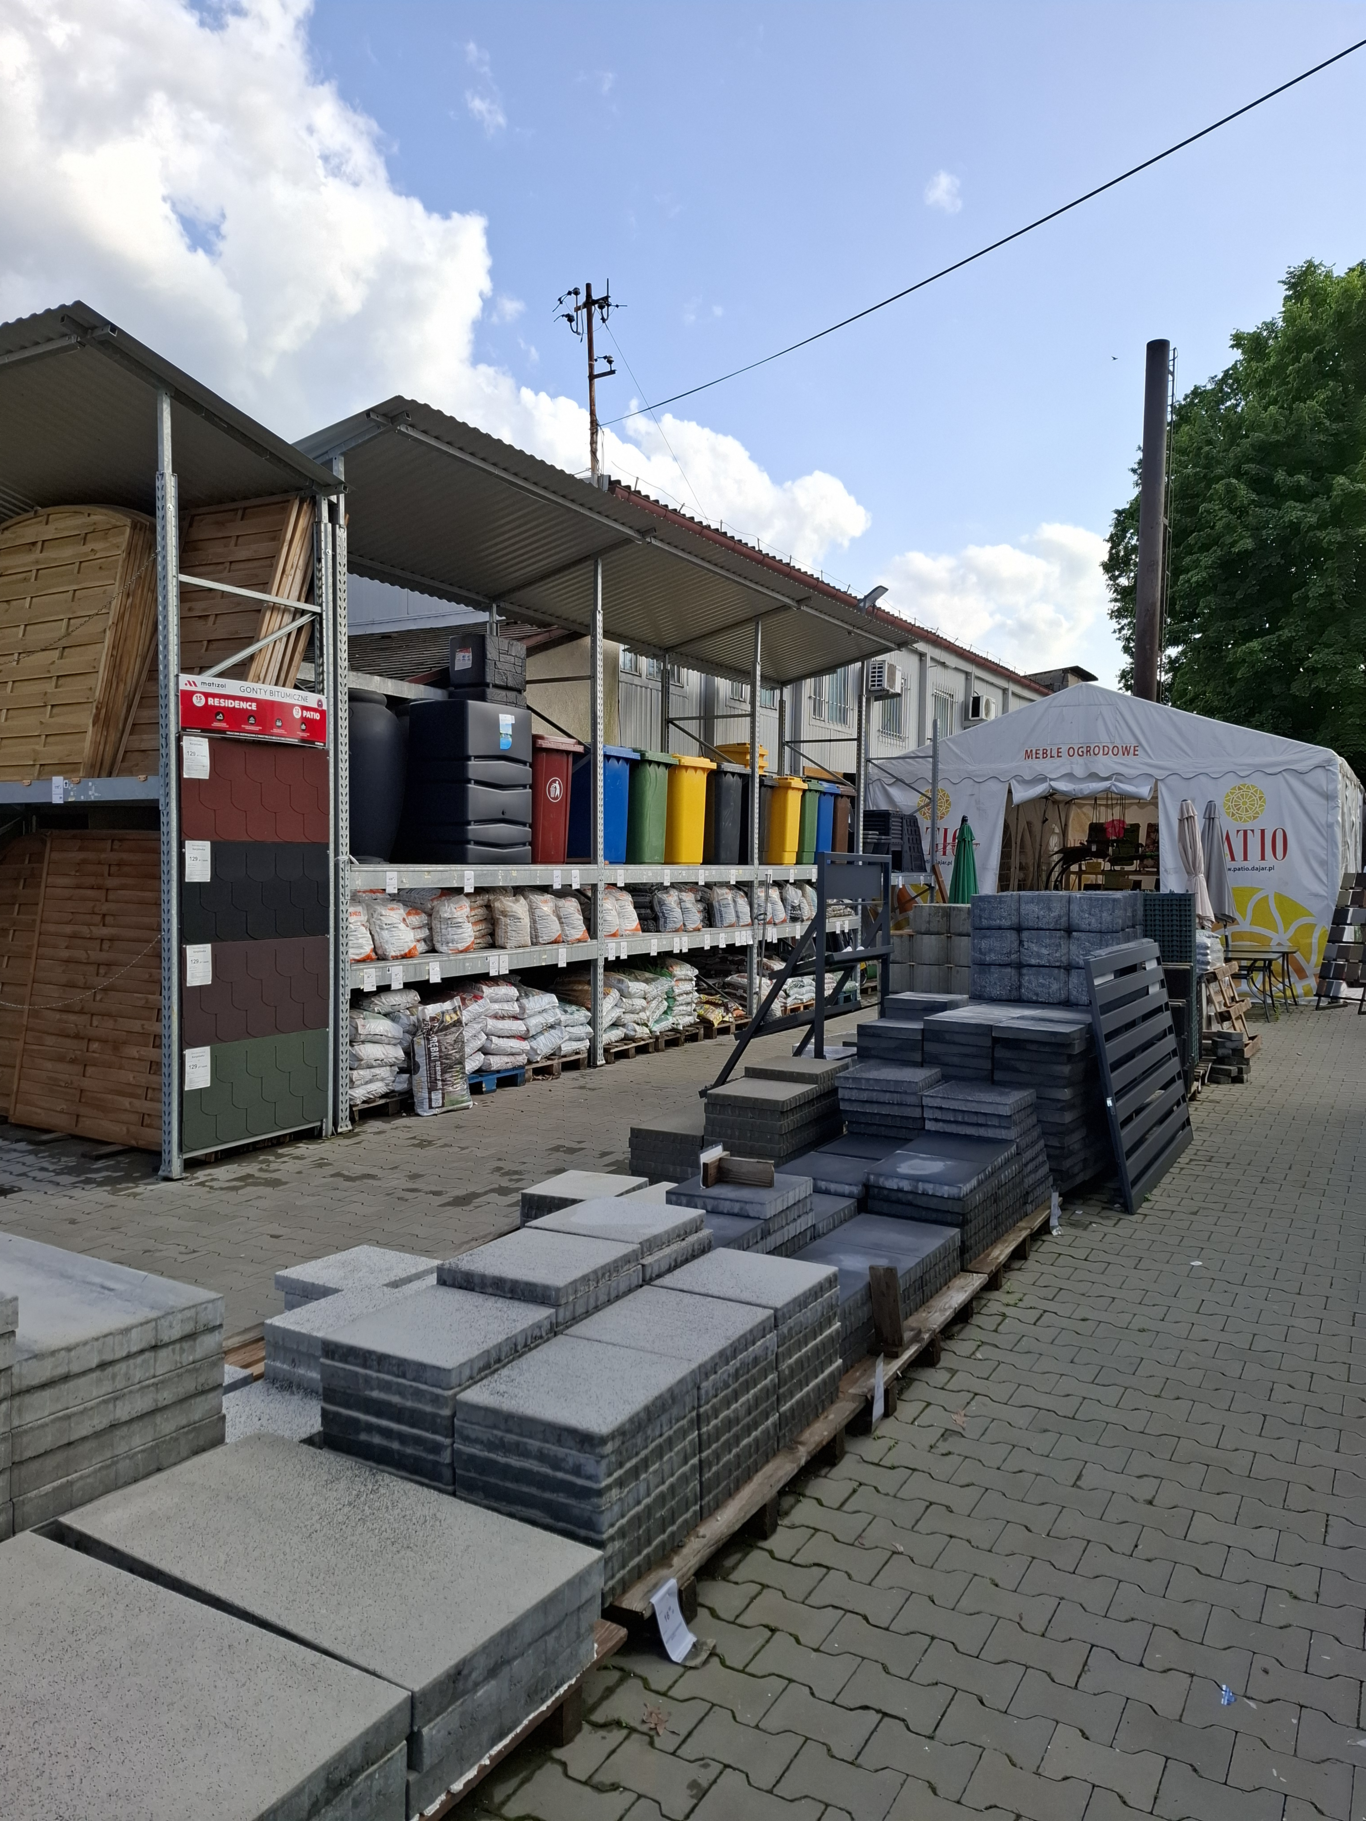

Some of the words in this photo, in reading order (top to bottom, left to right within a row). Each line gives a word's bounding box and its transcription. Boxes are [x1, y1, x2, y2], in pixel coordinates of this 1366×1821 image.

[200, 681, 227, 689] matizol
[239, 685, 268, 696] GONTY
[269, 690, 309, 703] BITUMICZNE
[207, 697, 257, 711] RESIDENCE
[302, 710, 321, 720] PATIO
[1024, 747, 1063, 760] MEBLE
[1067, 744, 1139, 758] OGRODOWE
[1224, 827, 1288, 862] ATIO
